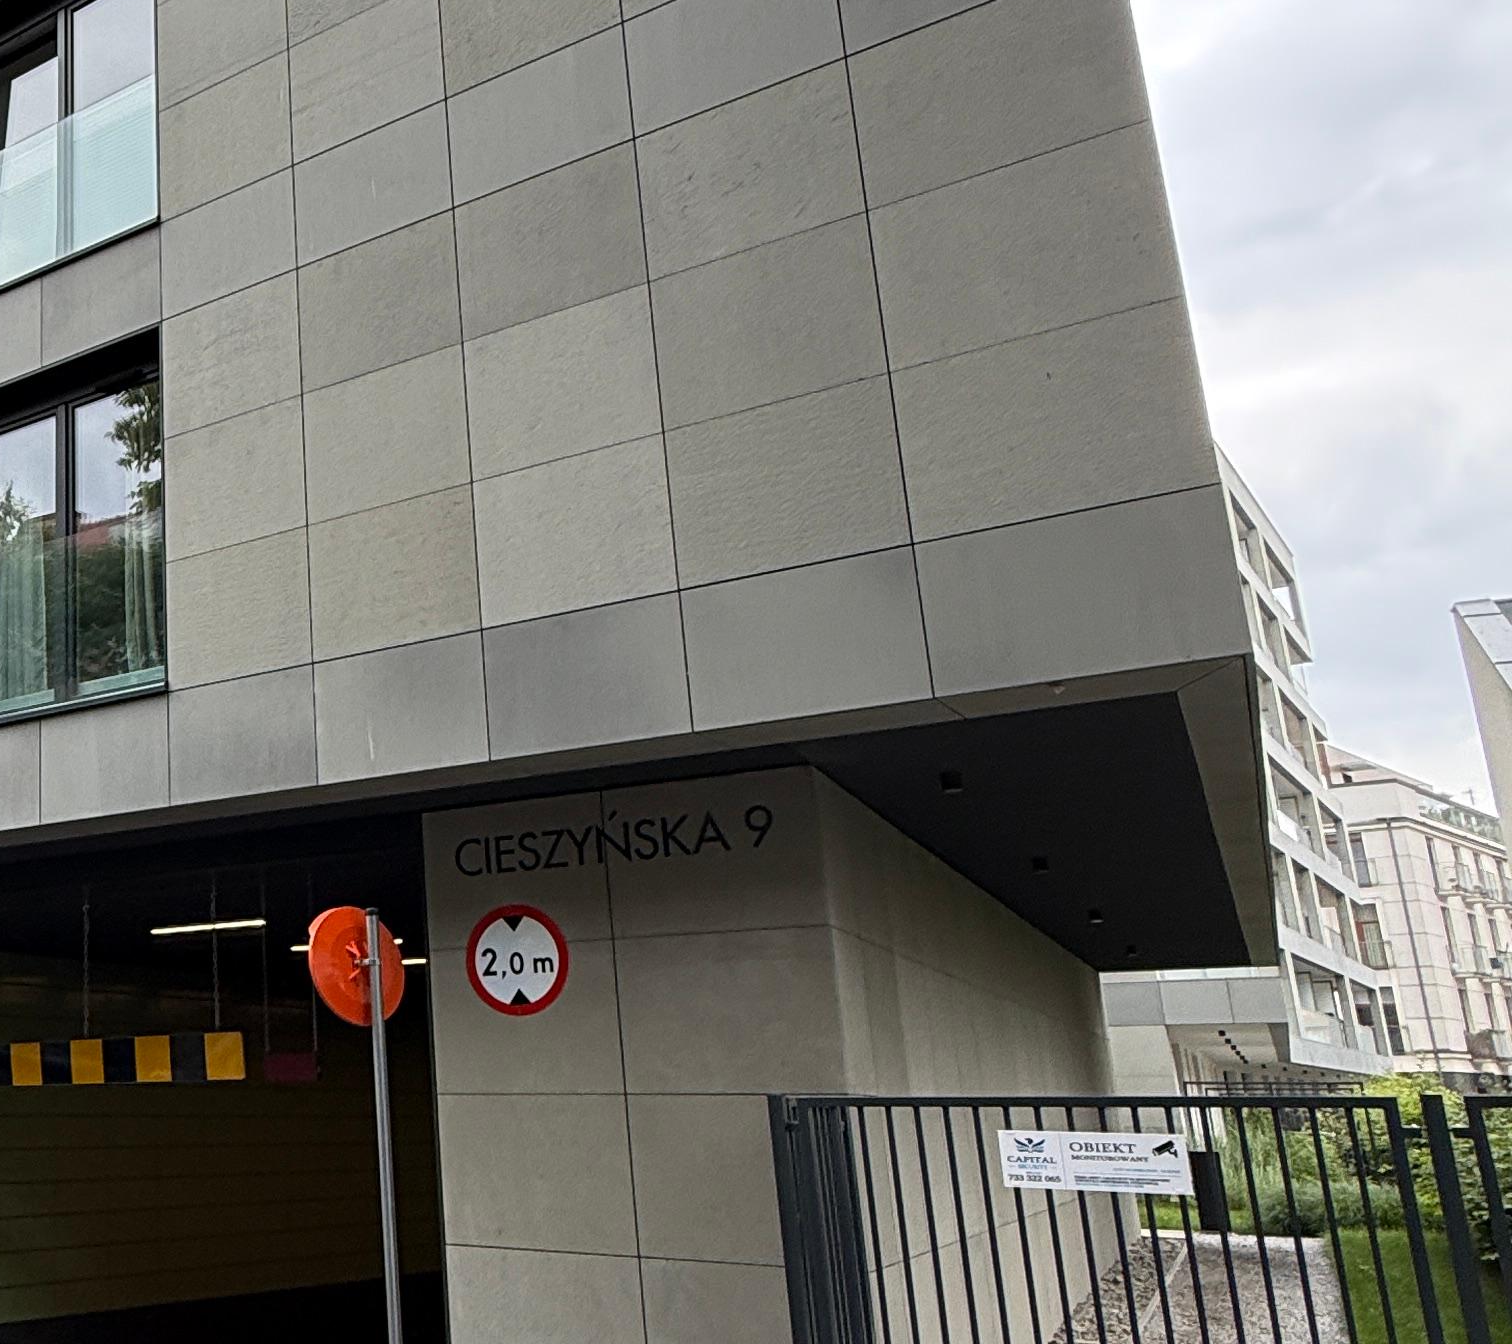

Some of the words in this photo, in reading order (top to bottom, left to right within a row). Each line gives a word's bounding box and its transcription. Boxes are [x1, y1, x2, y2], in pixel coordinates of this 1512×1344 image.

[455, 810, 731, 876] CIESZYŃSKA
[744, 805, 773, 848] 9
[481, 948, 524, 980] 2,0
[533, 957, 554, 973] m
[1069, 1142, 1136, 1154] OBIEKT
[1007, 1156, 1058, 1164] CAPITAL
[1008, 1174, 1024, 1182] 733
